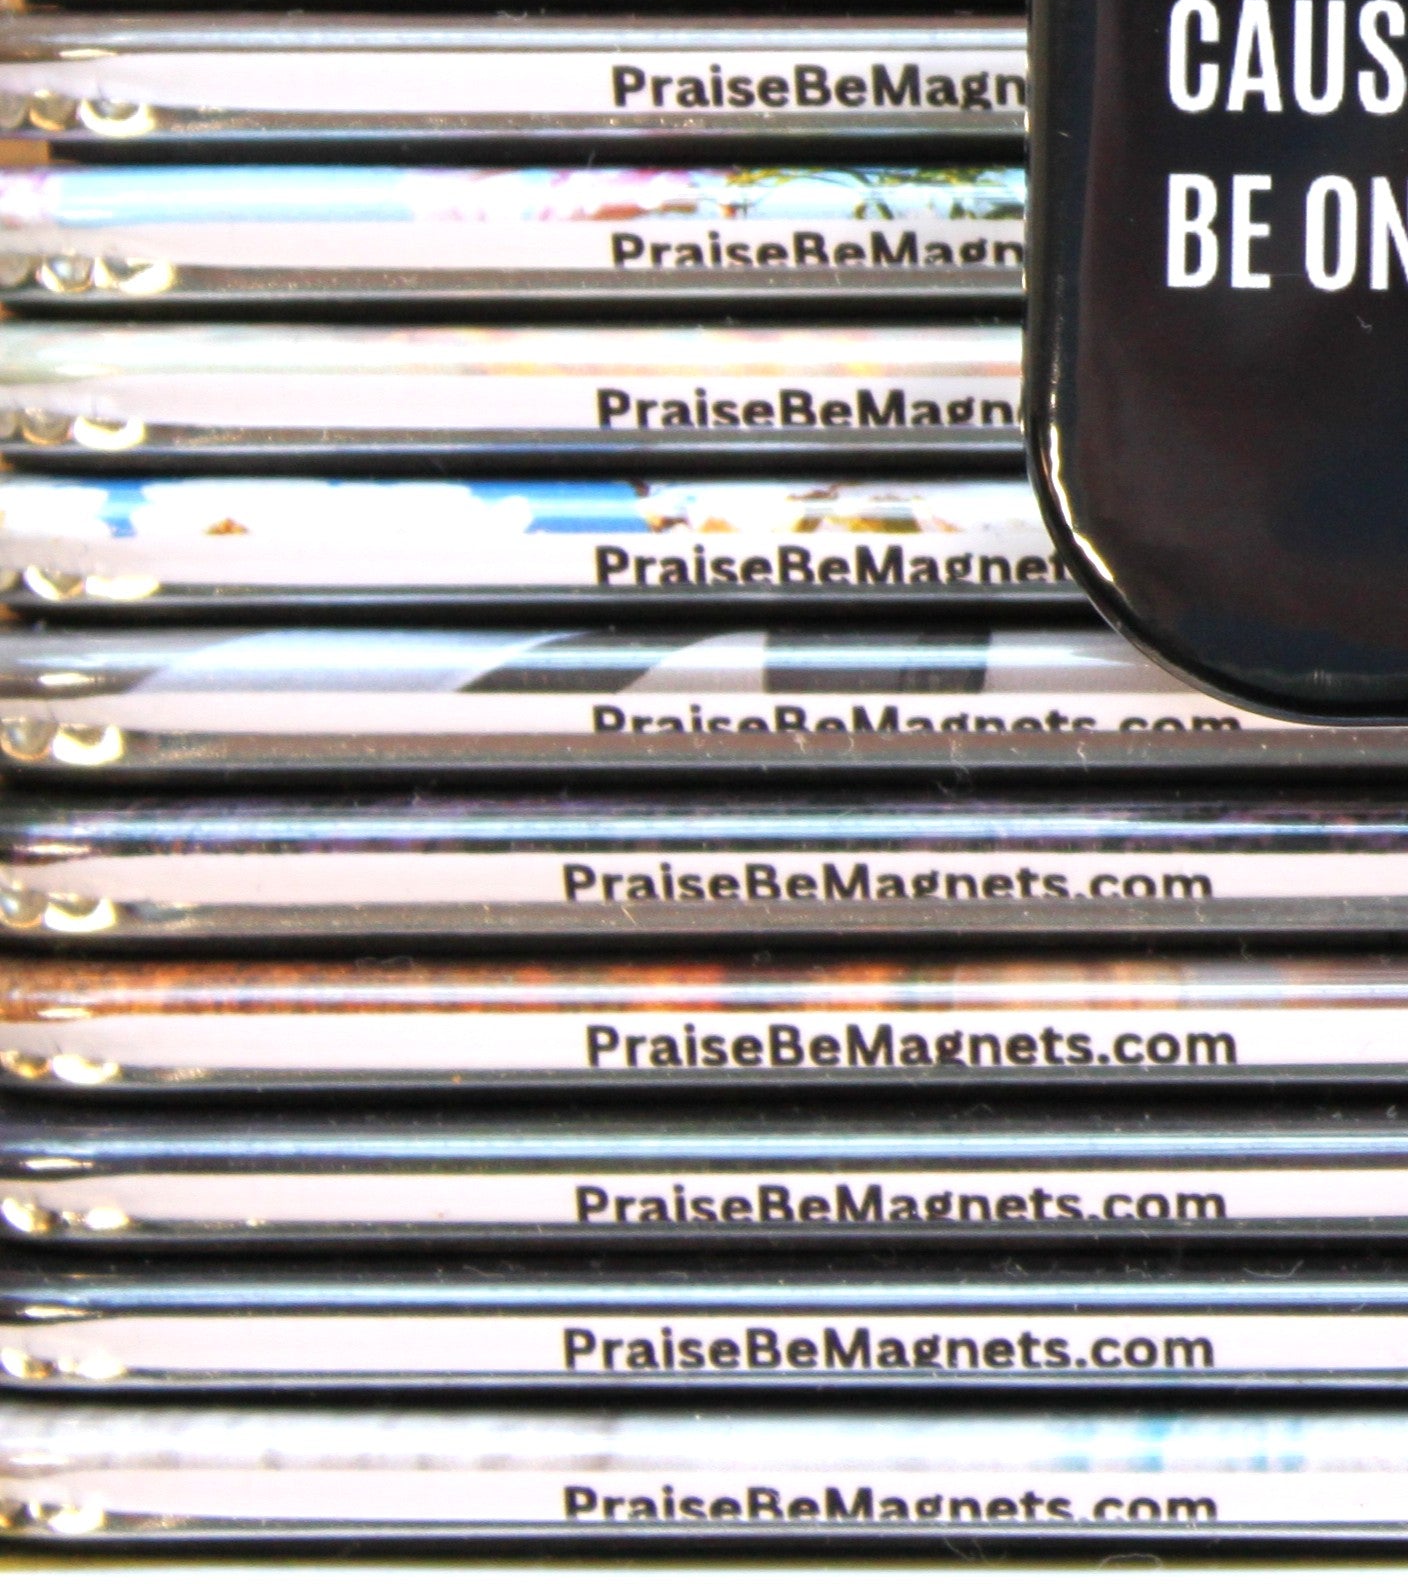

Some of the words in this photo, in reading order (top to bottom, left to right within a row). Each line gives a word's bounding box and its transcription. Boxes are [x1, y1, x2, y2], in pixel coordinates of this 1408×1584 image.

[612, 64, 1025, 110] PraiseBeMagn
[612, 232, 1023, 268] PraiseBeMagn
[1167, 173, 1272, 289] BE
[597, 389, 1024, 429] PraiseBeMagn
[587, 1024, 1237, 1067] PraiseBeMagnets.com
[563, 1327, 1215, 1369] PraiseBeMagnets.com
[564, 1487, 1218, 1522] PraiseBeMagnetscom
